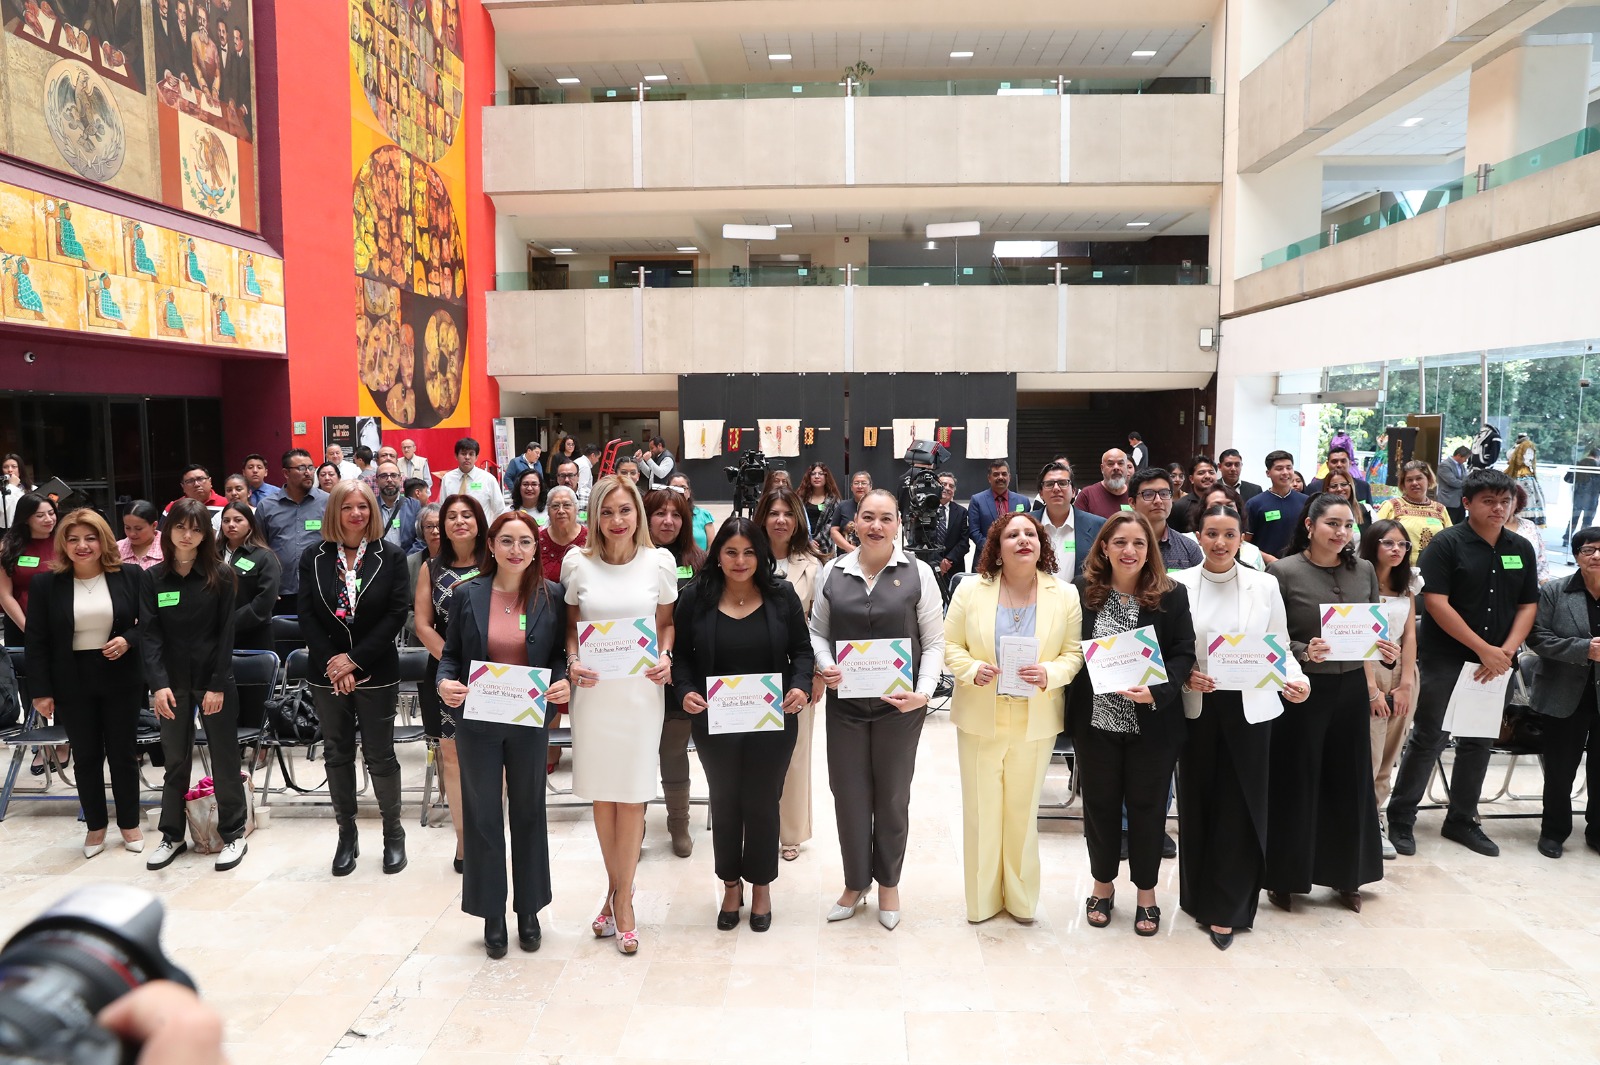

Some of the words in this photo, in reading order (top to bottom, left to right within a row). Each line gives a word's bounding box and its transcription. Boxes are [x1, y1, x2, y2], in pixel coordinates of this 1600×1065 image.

[584, 638, 637, 648] Reconocimiento
[1091, 650, 1140, 664] Reconocimiento
[473, 681, 528, 693] Reconocimiento
[712, 694, 763, 702] Reconocimiento
